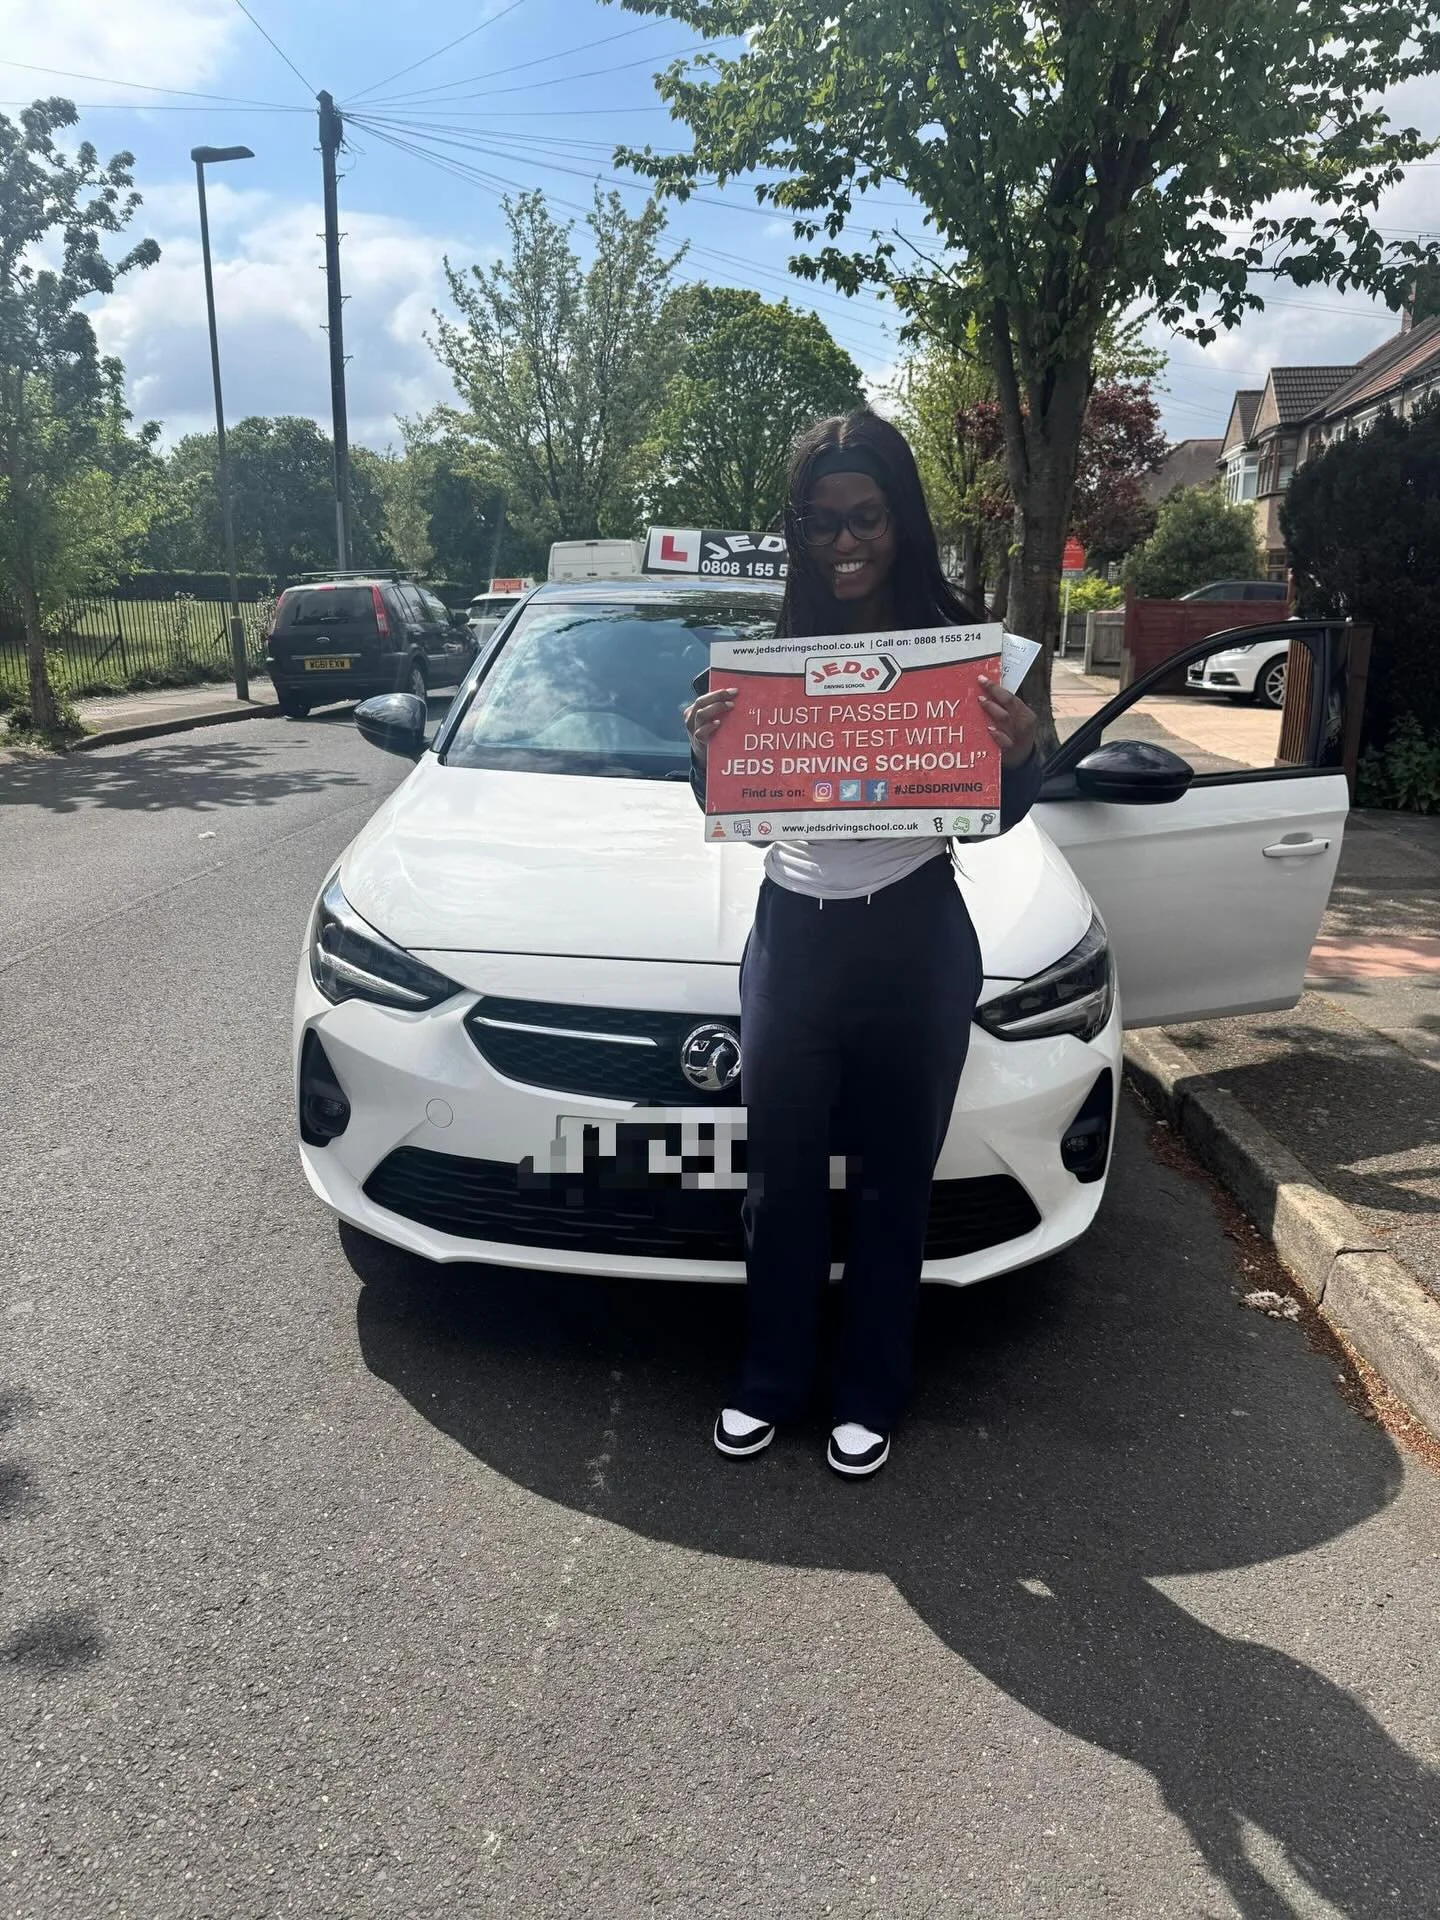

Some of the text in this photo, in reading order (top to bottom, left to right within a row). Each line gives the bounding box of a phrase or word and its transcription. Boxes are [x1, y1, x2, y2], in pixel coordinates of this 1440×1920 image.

[661, 535, 688, 562] L
[704, 534, 788, 560] JED
[701, 560, 740, 575] 0808
[746, 562, 774, 576] 155
[732, 640, 865, 655] www.jedsdrivingschool.co.uk
[876, 638, 894, 648] Call
[896, 639, 912, 647] on:
[914, 635, 937, 645] 0808
[939, 634, 962, 643] 1555
[964, 632, 982, 641] 214
[809, 661, 880, 683] JEDS
[767, 706, 823, 725] JUST
[829, 702, 919, 723] PASSED
[926, 699, 961, 719] MY
[744, 725, 964, 751] DRIVING TEST WITH
[721, 758, 775, 776] JEDS
[781, 755, 869, 775] DRIVING
[741, 788, 767, 798] Find
[769, 789, 783, 798] us
[787, 789, 805, 797] on:
[894, 783, 983, 796] #JEDSDRIVING
[782, 822, 919, 834] www.jedsdrivingschool.co.uk
